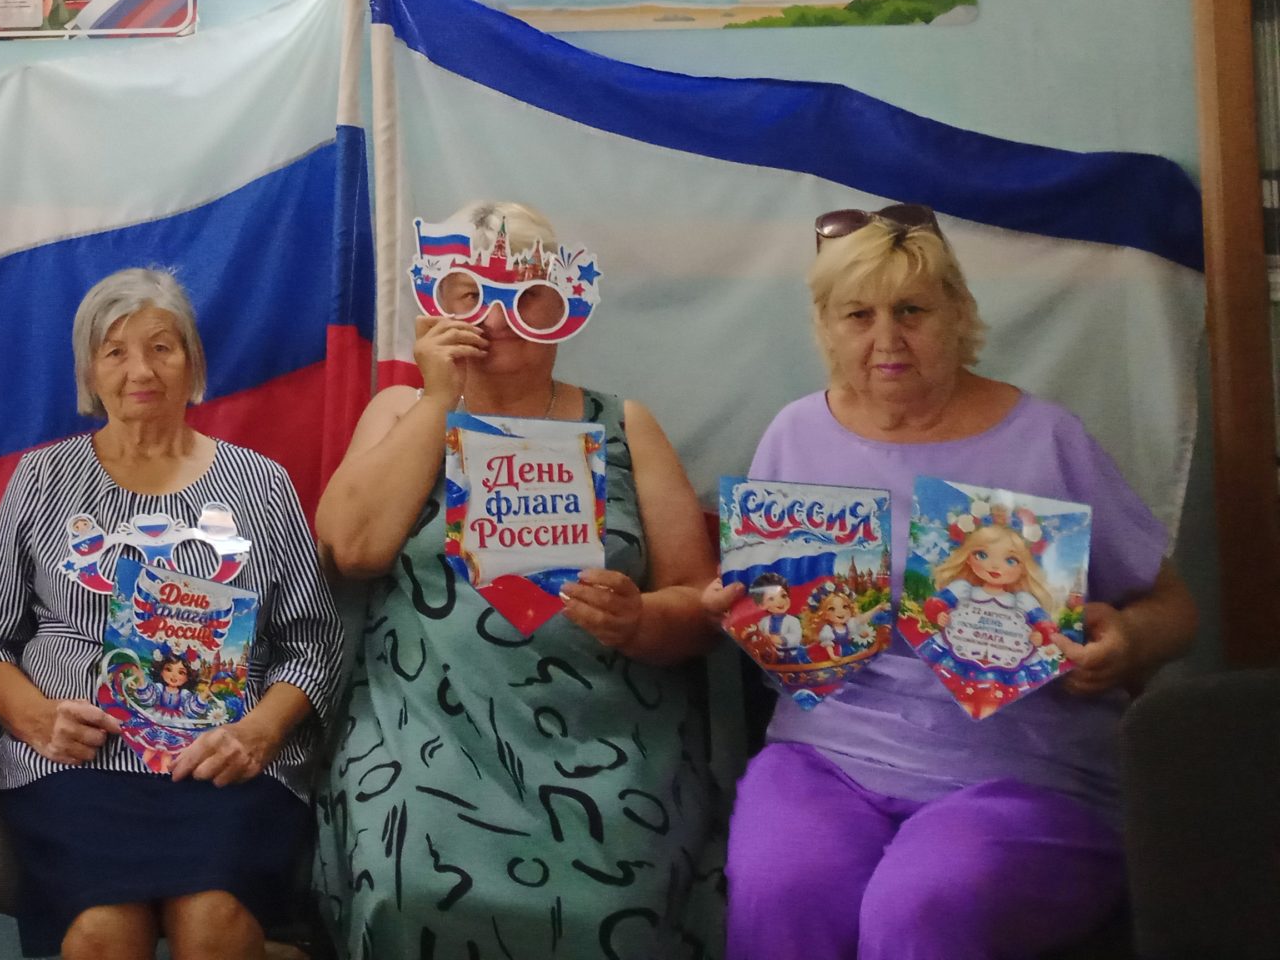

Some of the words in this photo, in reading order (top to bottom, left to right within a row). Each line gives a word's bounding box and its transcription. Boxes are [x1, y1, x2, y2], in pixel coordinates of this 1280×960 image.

[482, 453, 574, 493] День
[485, 490, 581, 524] флага
[469, 517, 590, 548] России
[159, 582, 210, 609] День
[972, 630, 1005, 643] ФЛАГА
